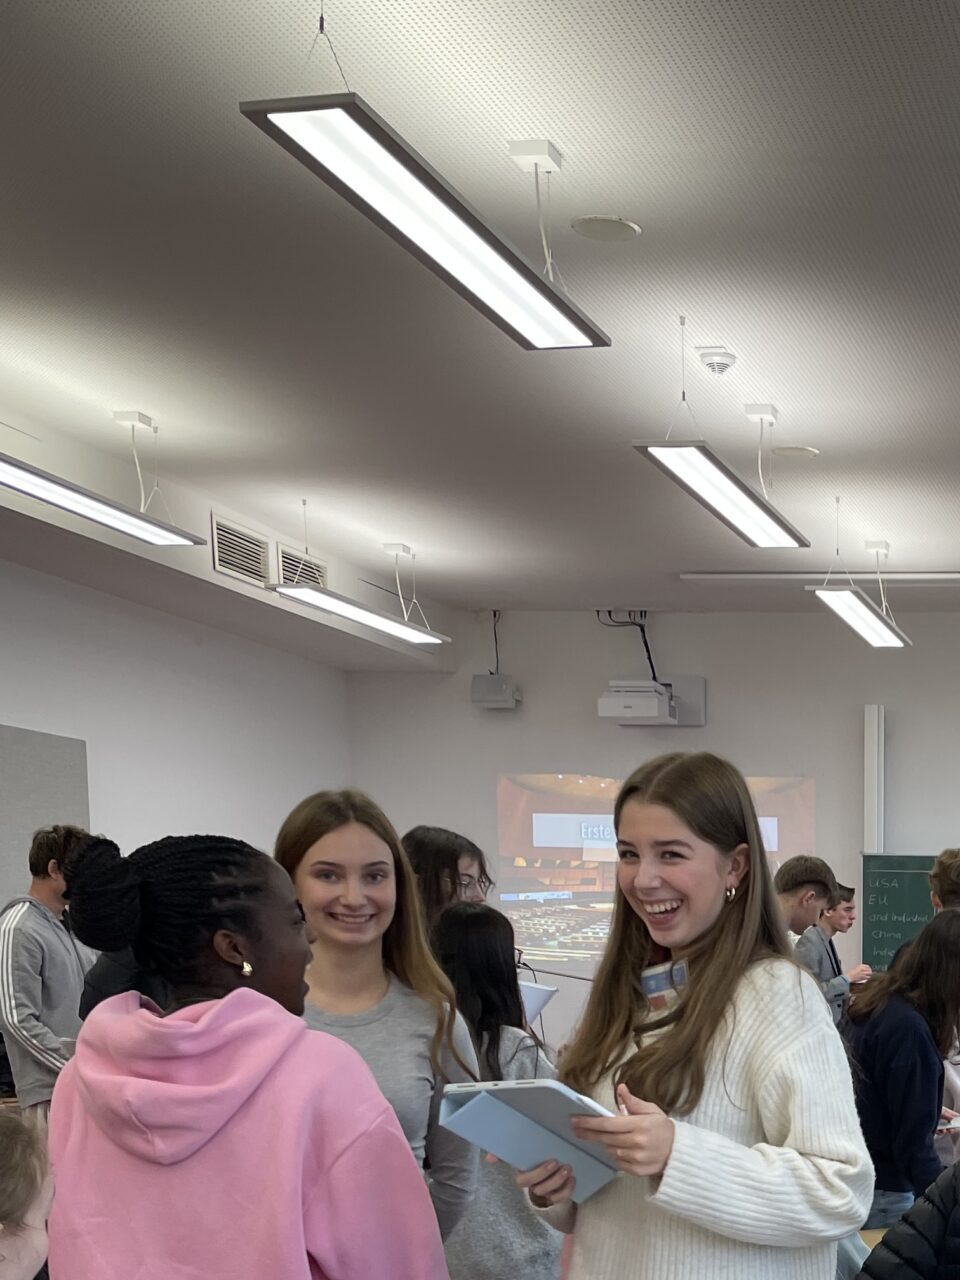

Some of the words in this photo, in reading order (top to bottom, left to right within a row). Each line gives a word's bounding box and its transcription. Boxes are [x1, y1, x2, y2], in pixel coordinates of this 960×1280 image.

[581, 822, 611, 840] Erste
[869, 879, 899, 889] USA
[868, 894, 889, 906] EU
